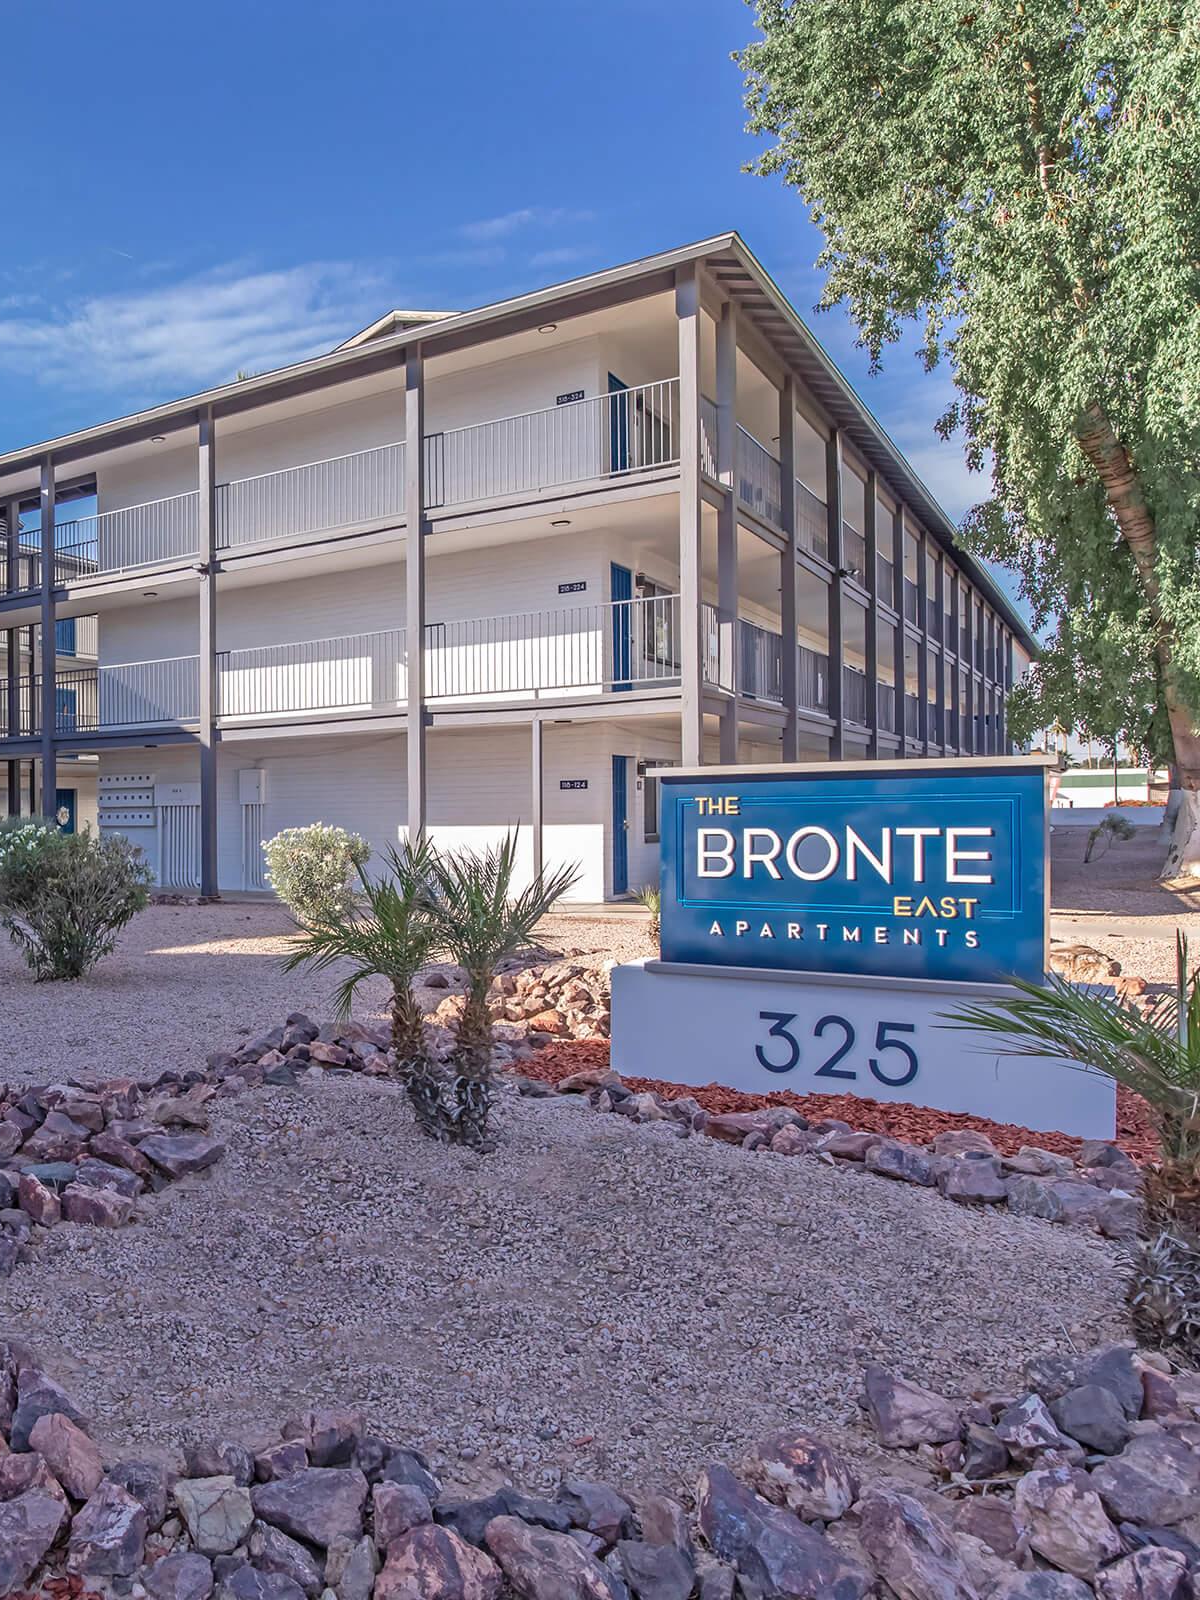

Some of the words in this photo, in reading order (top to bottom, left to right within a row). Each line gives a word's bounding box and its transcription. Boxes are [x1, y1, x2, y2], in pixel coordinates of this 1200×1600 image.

[695, 796, 740, 815] THE
[696, 825, 994, 884] BRONTE
[893, 896, 979, 919] EAST
[709, 920, 979, 947] APARTMENTS
[755, 1011, 919, 1087] 325
